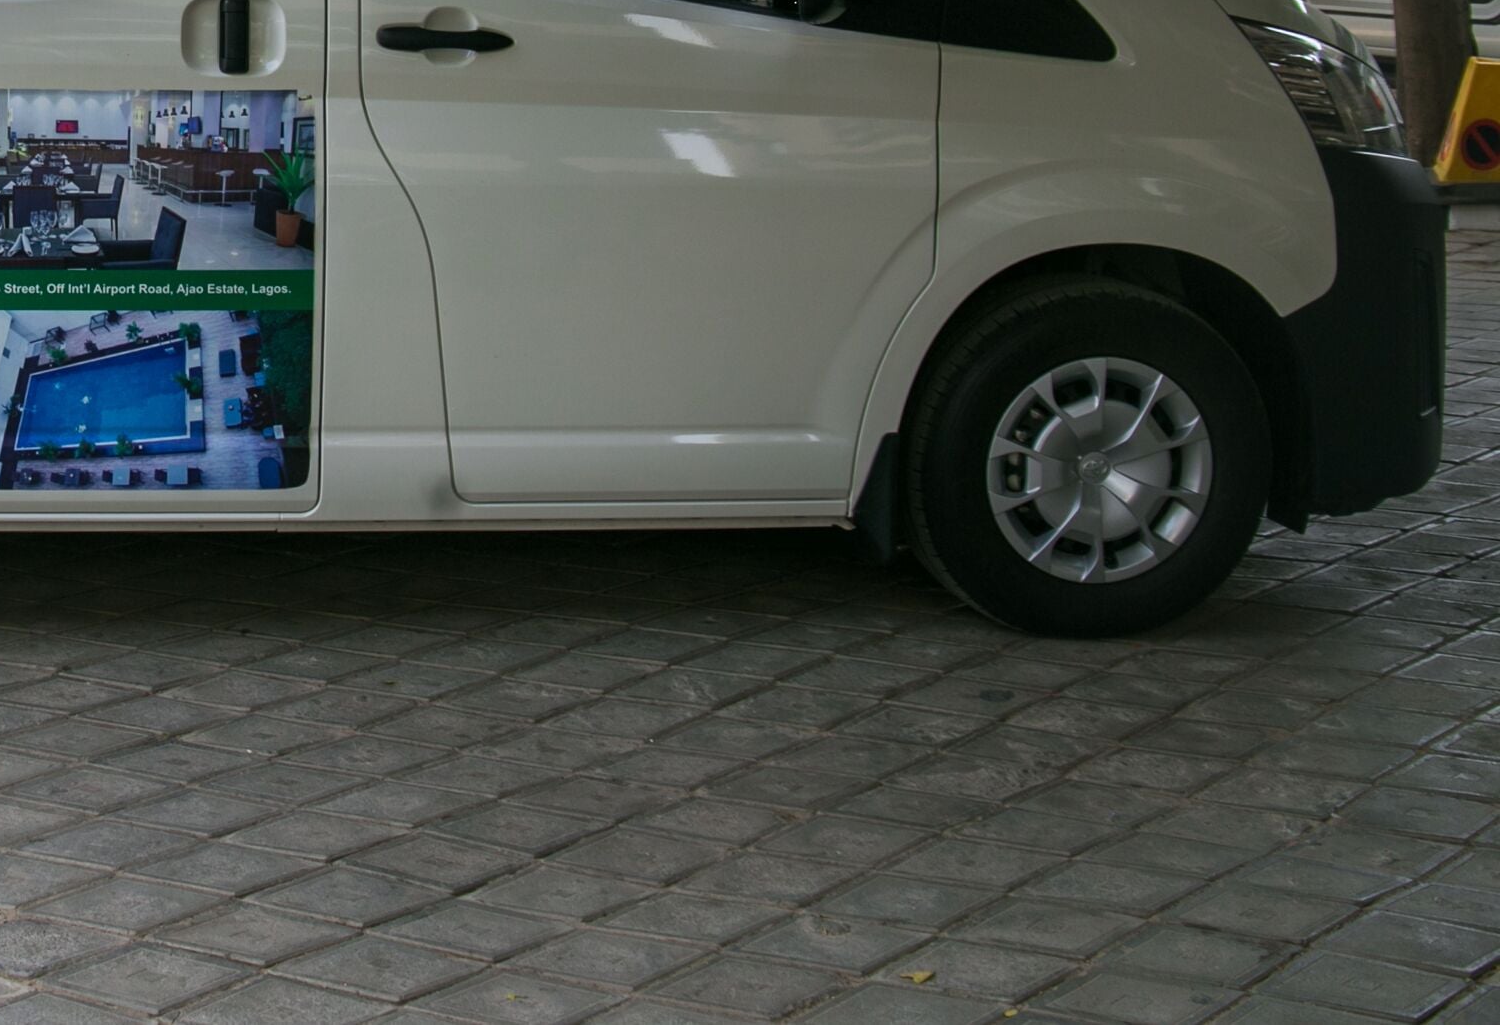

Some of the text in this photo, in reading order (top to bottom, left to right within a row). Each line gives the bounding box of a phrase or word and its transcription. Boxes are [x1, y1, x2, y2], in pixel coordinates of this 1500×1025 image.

[4, 283, 43, 295] Street,
[46, 283, 65, 294] Off
[93, 283, 135, 296] Airport
[138, 283, 174, 295] Road,
[176, 283, 204, 296] Ajao
[207, 283, 248, 295] Estate,
[251, 283, 292, 296] Lagos.
